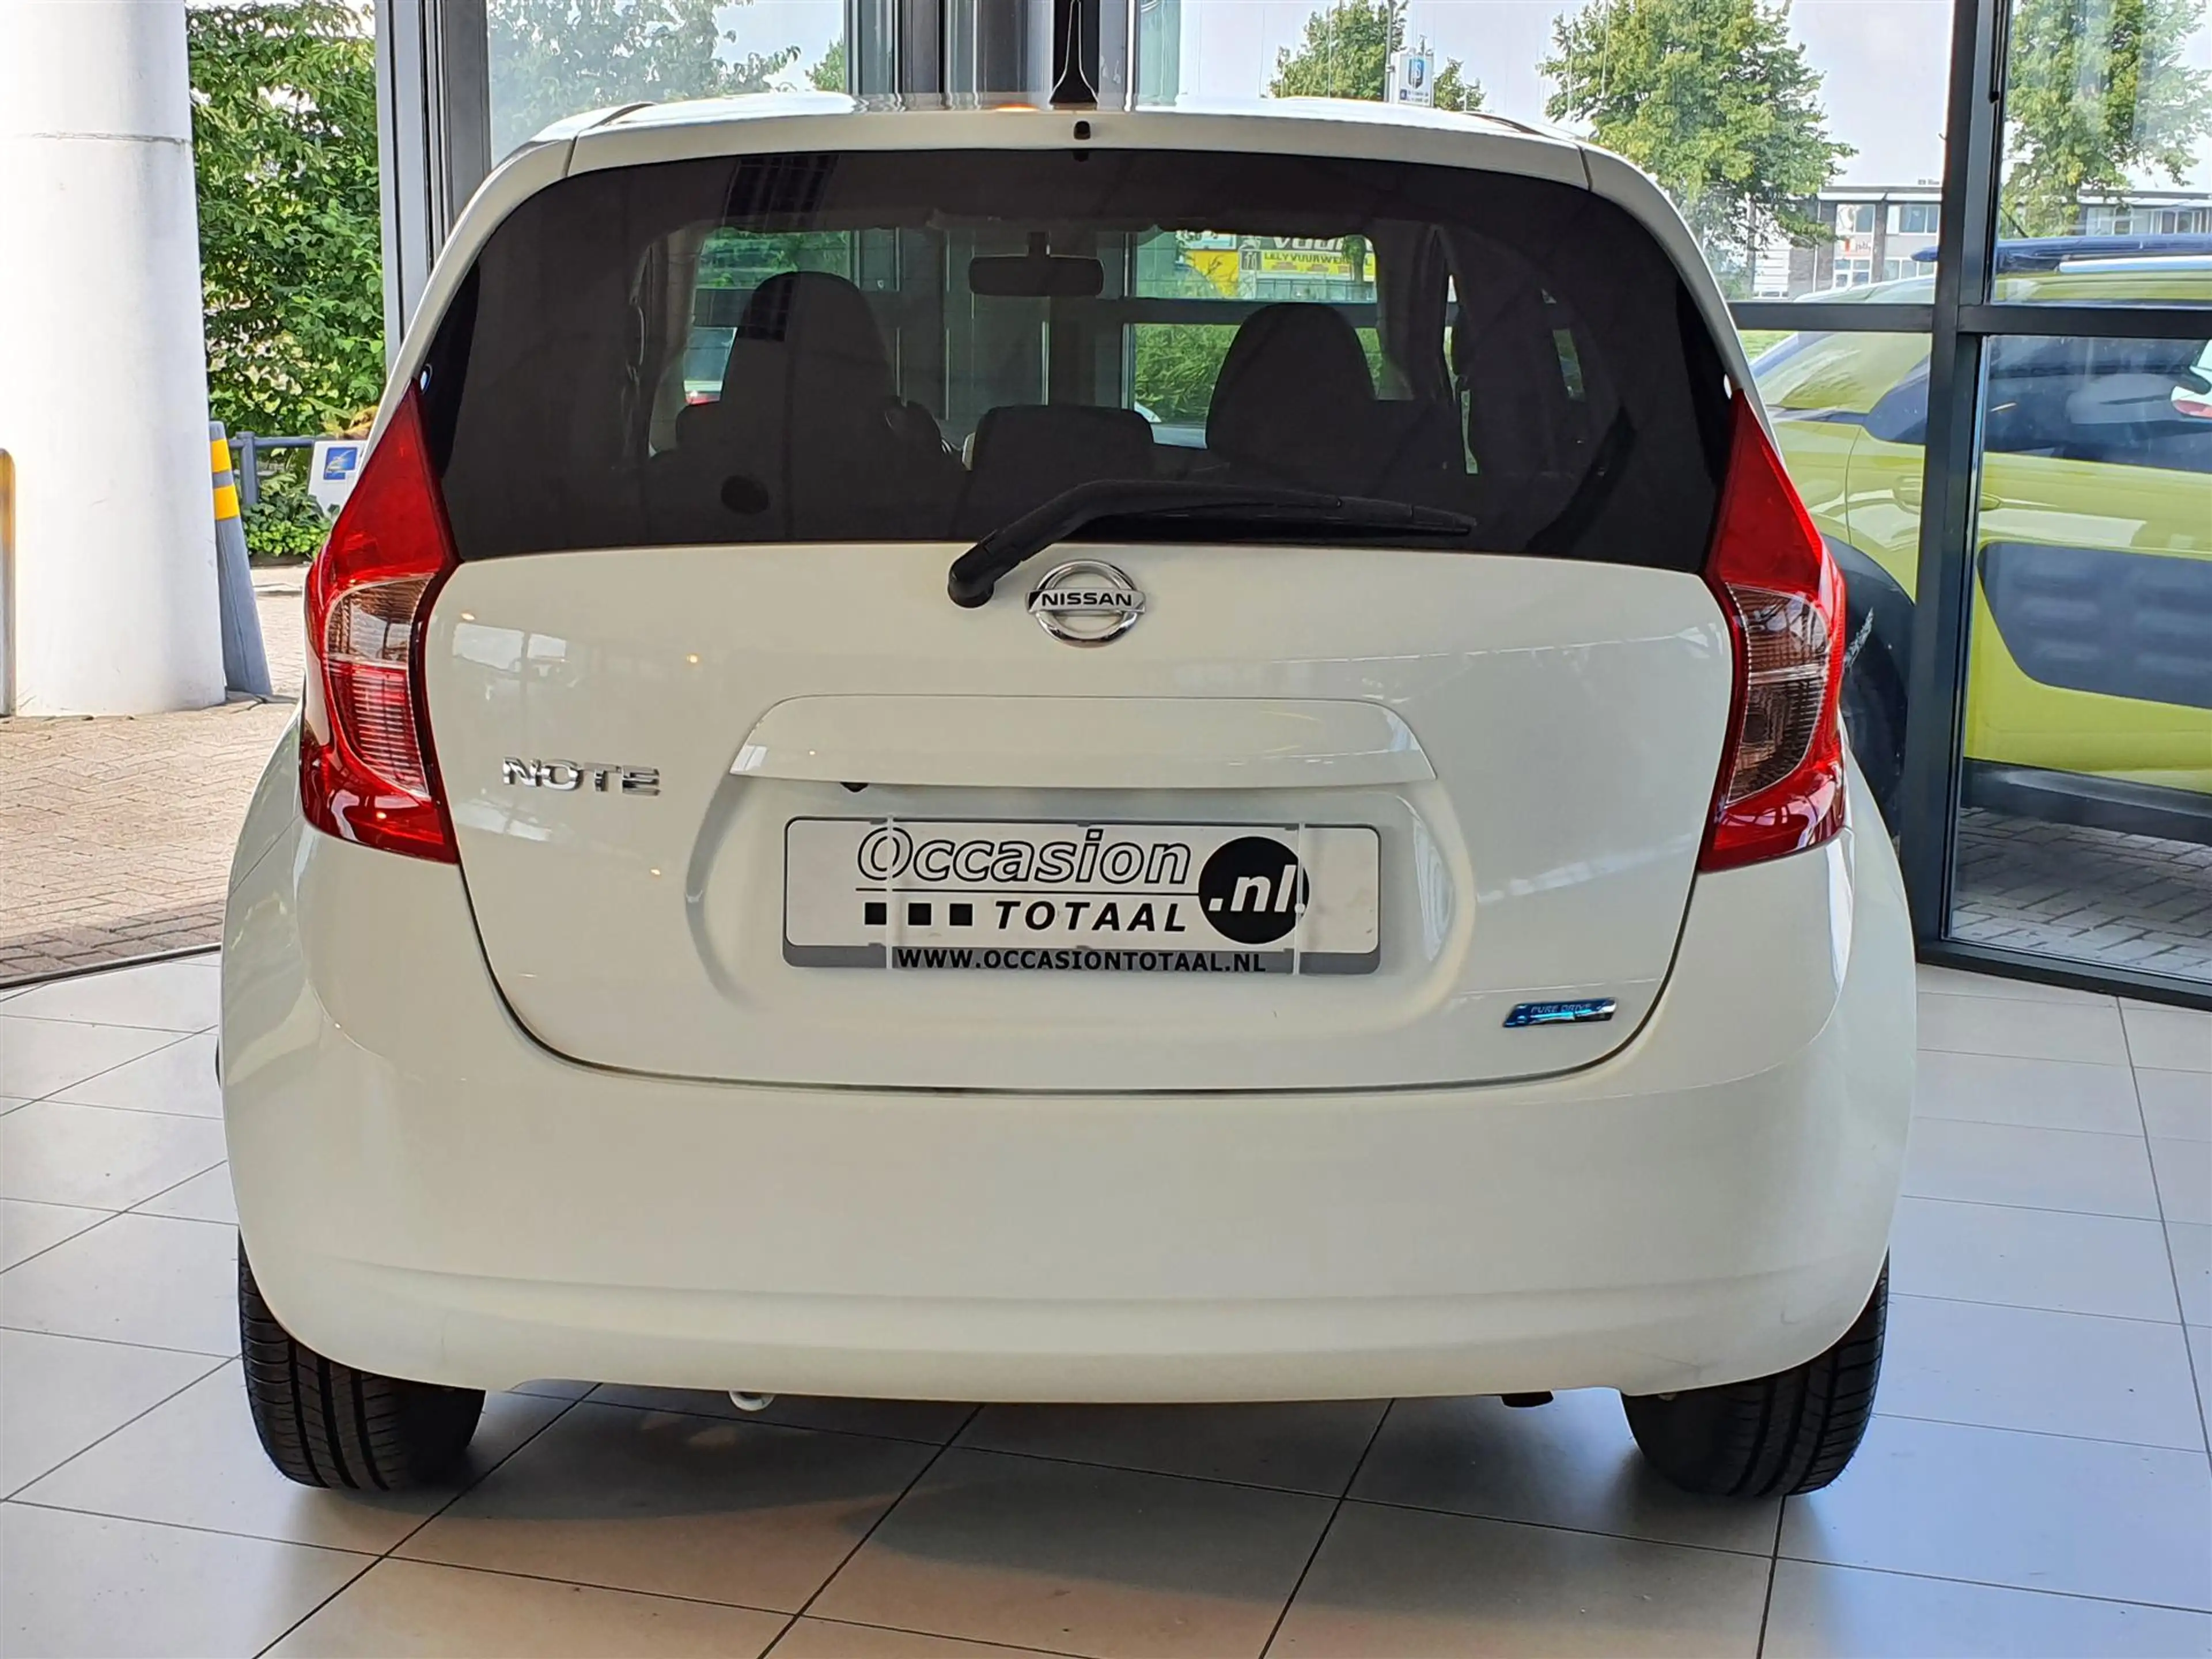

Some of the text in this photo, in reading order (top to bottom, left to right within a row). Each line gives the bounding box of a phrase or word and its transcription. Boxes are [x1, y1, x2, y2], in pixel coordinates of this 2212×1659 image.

[1041, 592, 1132, 607] NISSAN
[502, 756, 661, 797] NOTE
[857, 826, 1192, 885] Occasion
[1207, 864, 1297, 913] .nl
[995, 900, 1186, 933] TOTAAL
[897, 949, 1267, 973] WWW.OCCASIONTOTAAL.NL
[1531, 1005, 1559, 1014] PURE
